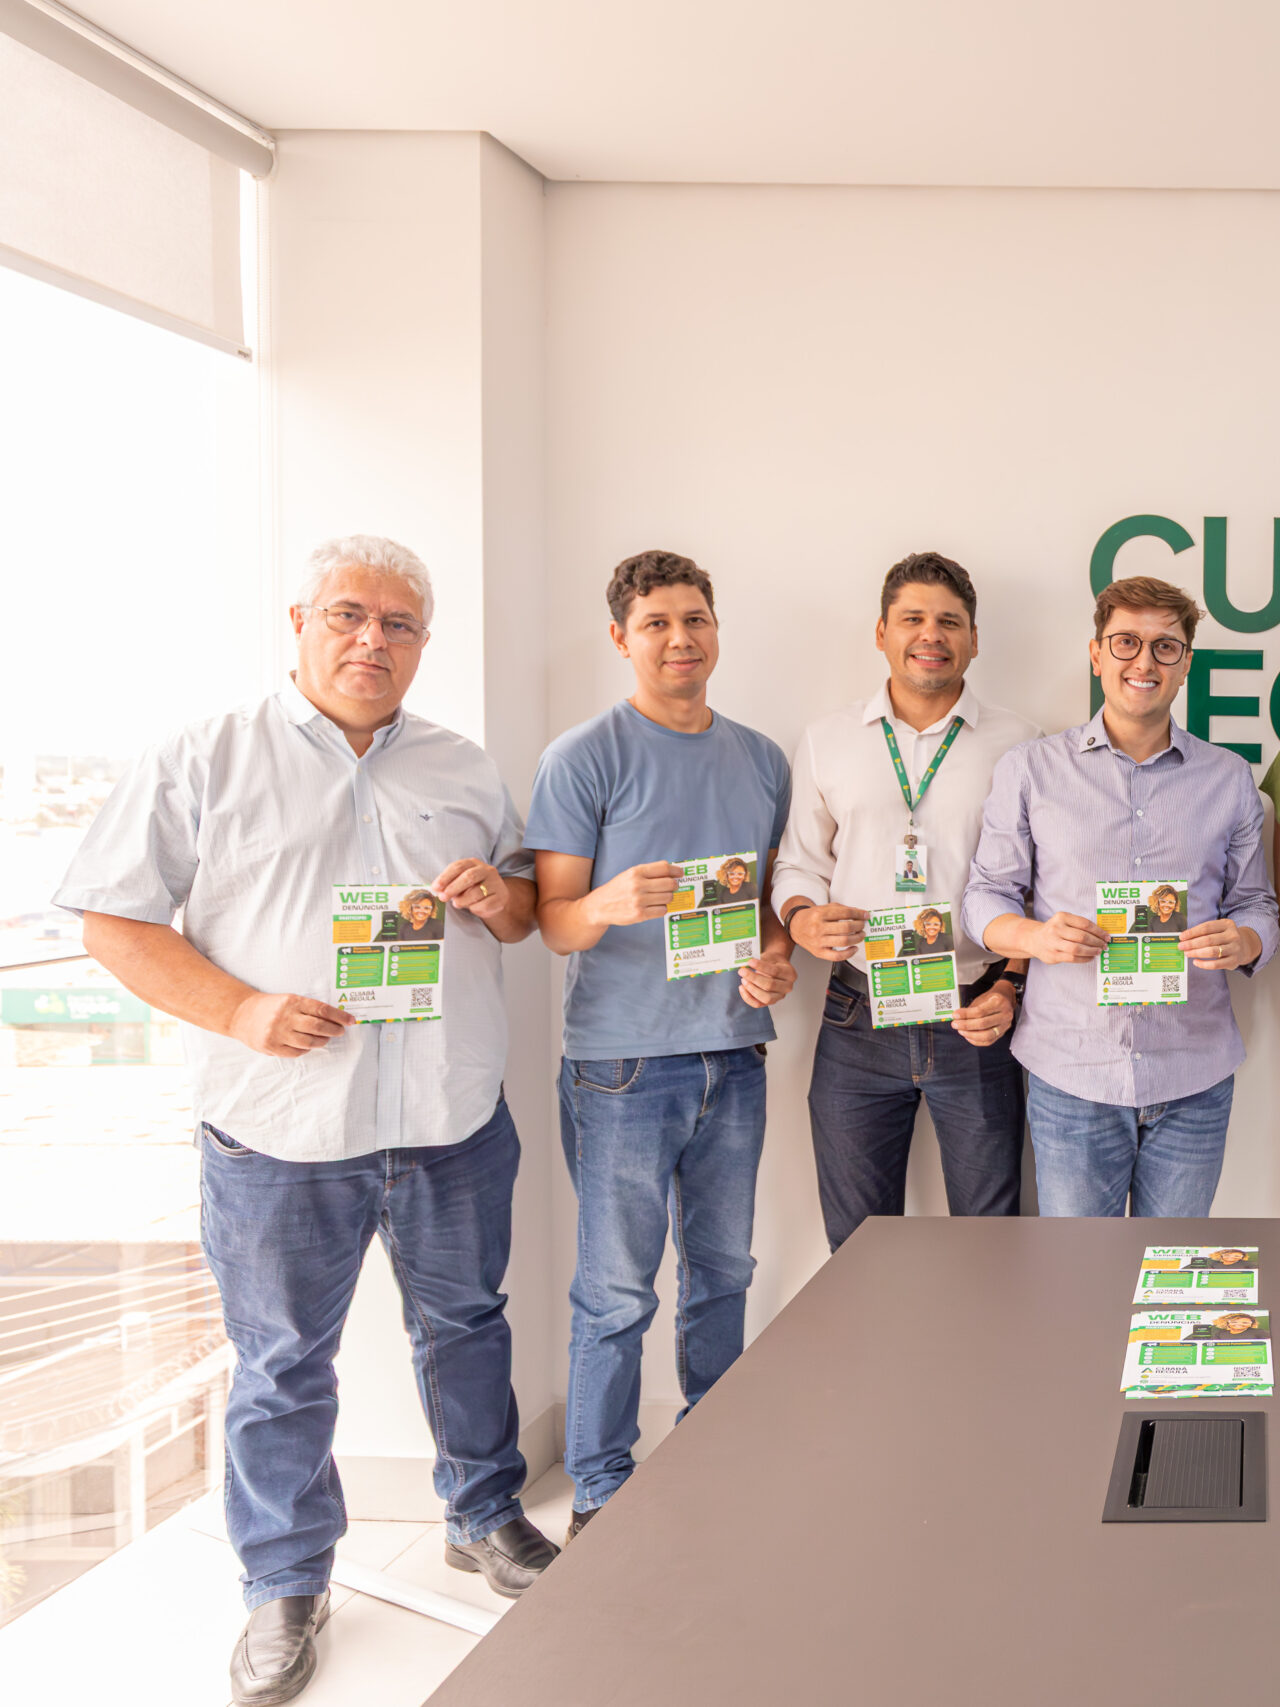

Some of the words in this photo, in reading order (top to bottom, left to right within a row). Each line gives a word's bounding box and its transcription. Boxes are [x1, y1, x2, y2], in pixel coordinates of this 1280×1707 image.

[684, 864, 708, 876] EB
[340, 892, 389, 903] WEB
[1102, 888, 1140, 898] WEB
[868, 914, 905, 926] WEB
